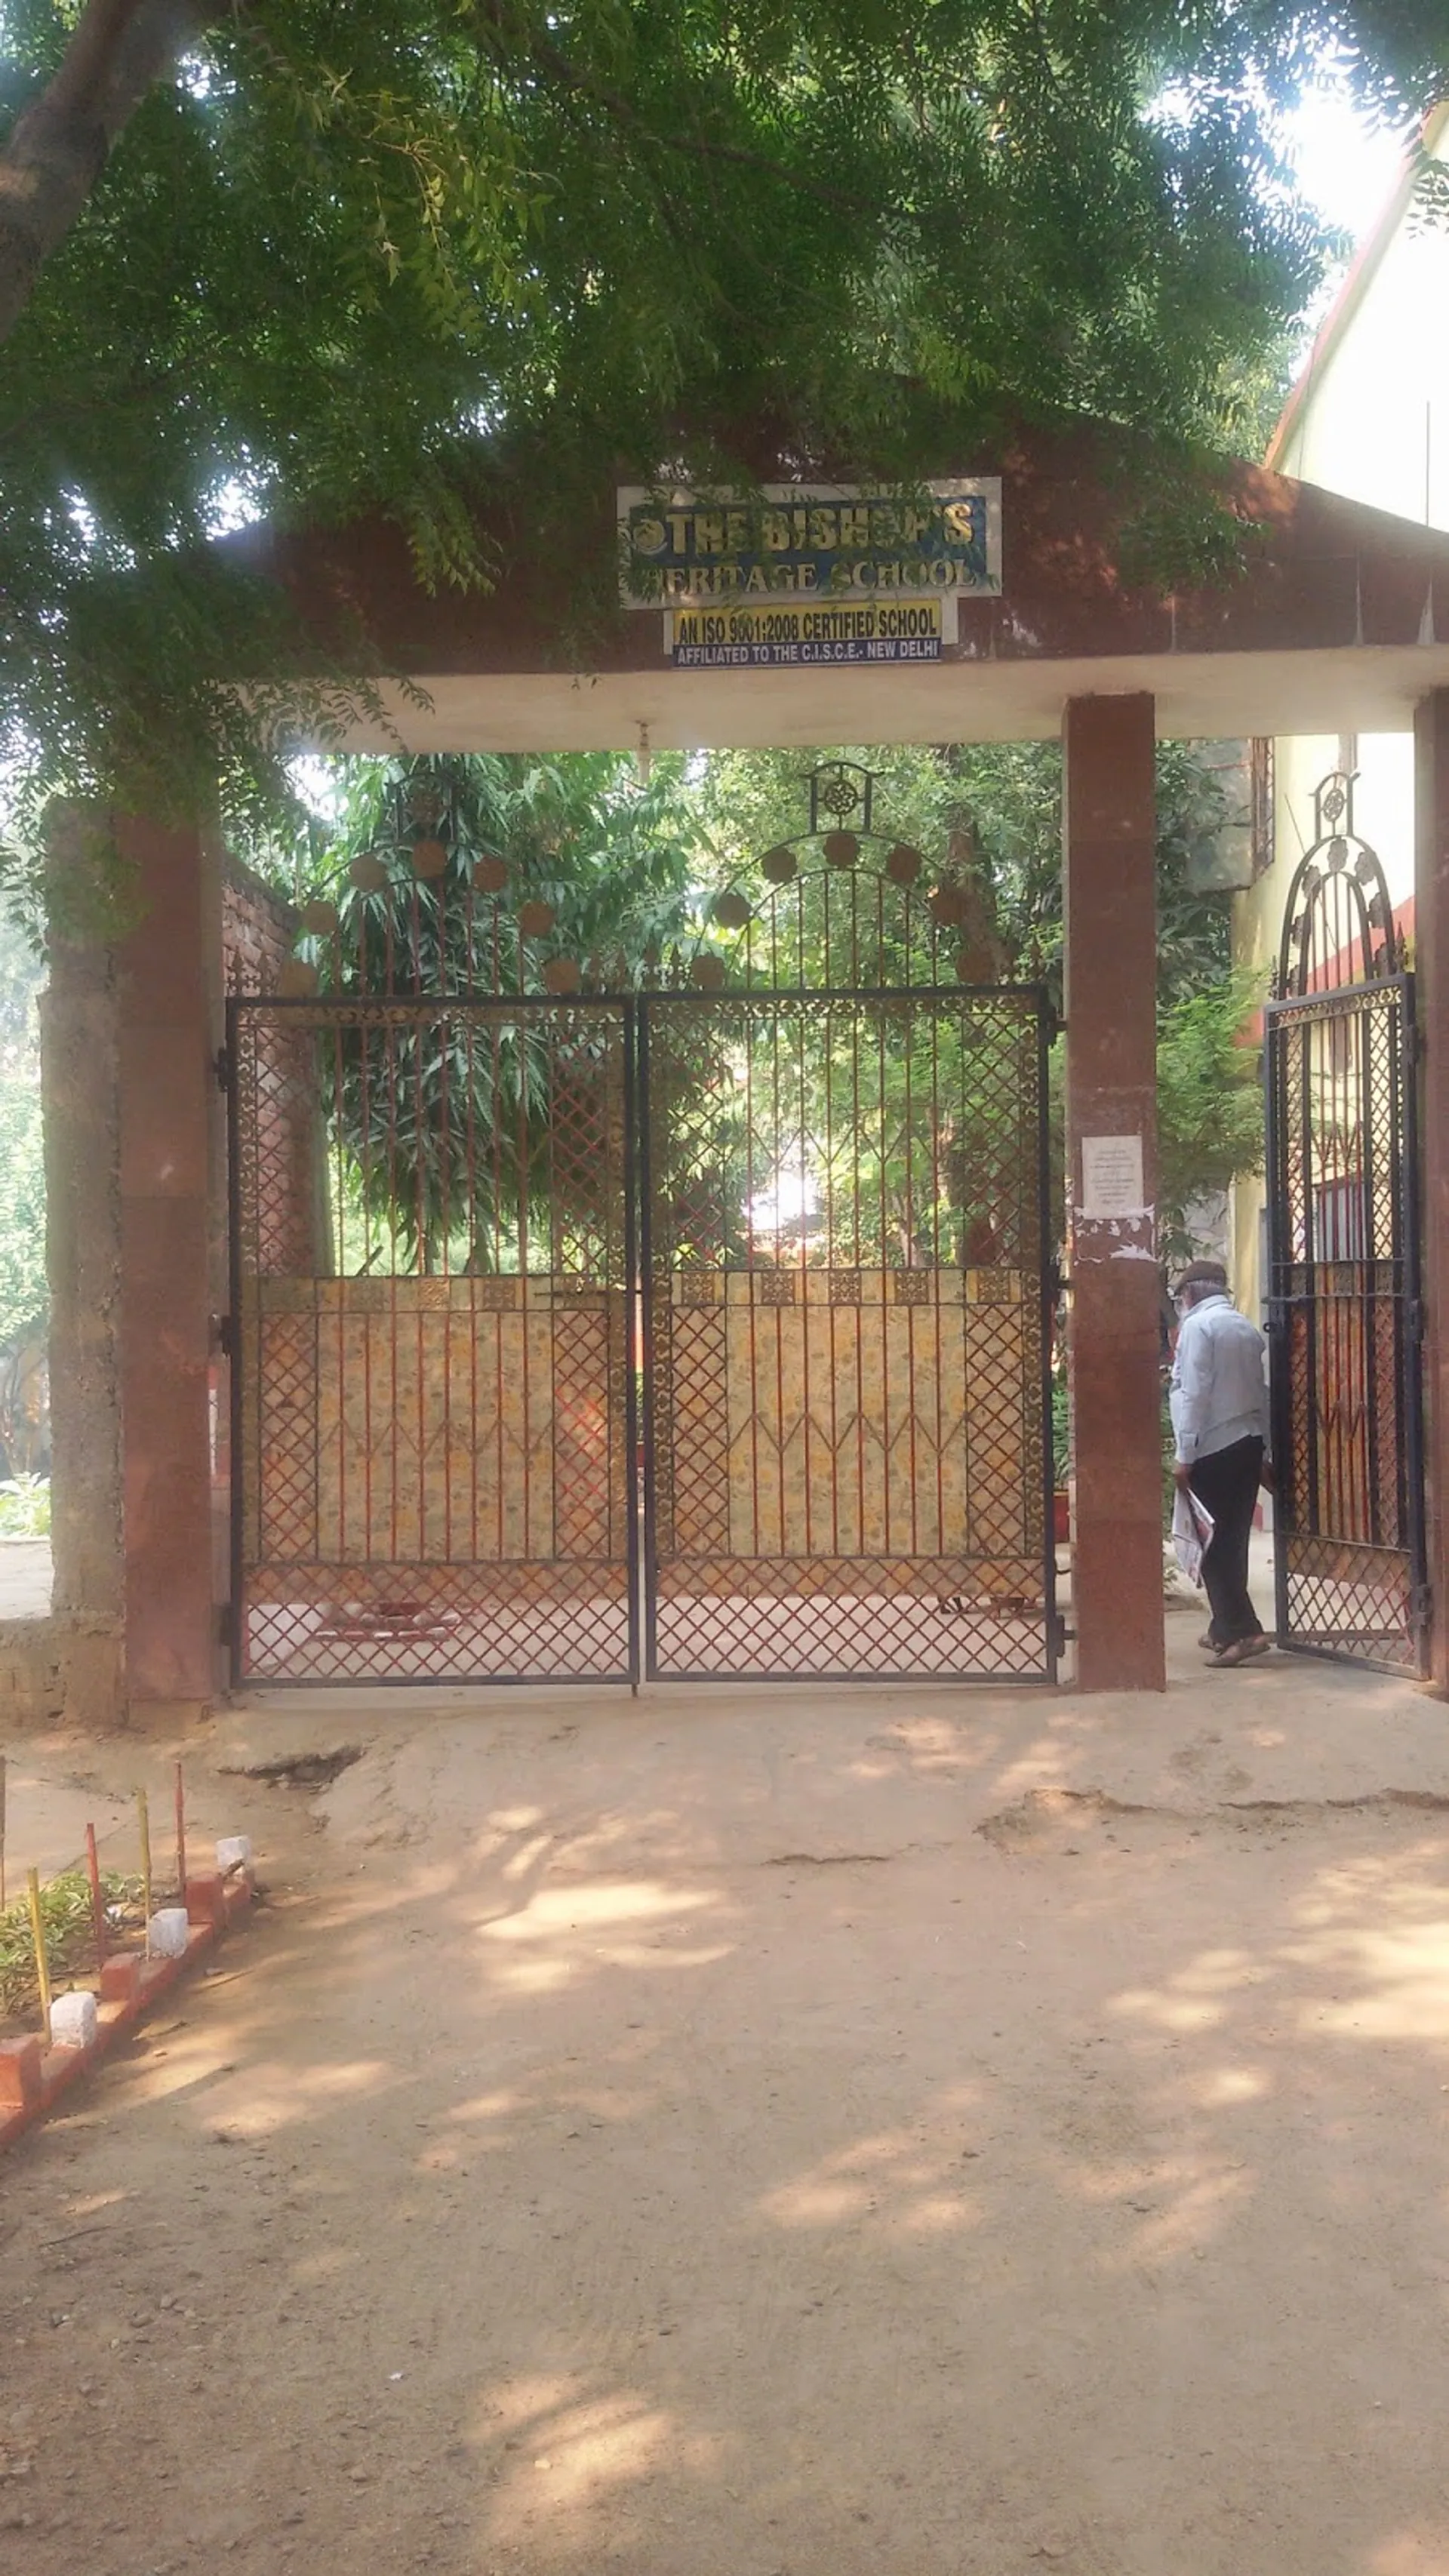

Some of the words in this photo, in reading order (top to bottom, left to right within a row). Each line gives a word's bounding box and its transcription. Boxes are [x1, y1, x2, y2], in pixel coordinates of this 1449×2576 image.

[678, 617, 698, 644] AN
[702, 615, 724, 643] ISO
[730, 613, 799, 643] 9001:2008
[803, 611, 875, 640] CERTIFIED
[878, 608, 937, 637] SCHOOL
[678, 645, 749, 664] AFFILIATED
[752, 646, 769, 662] TO
[773, 645, 798, 661] THE
[867, 641, 897, 658] NEW
[900, 640, 938, 657] DELHI
